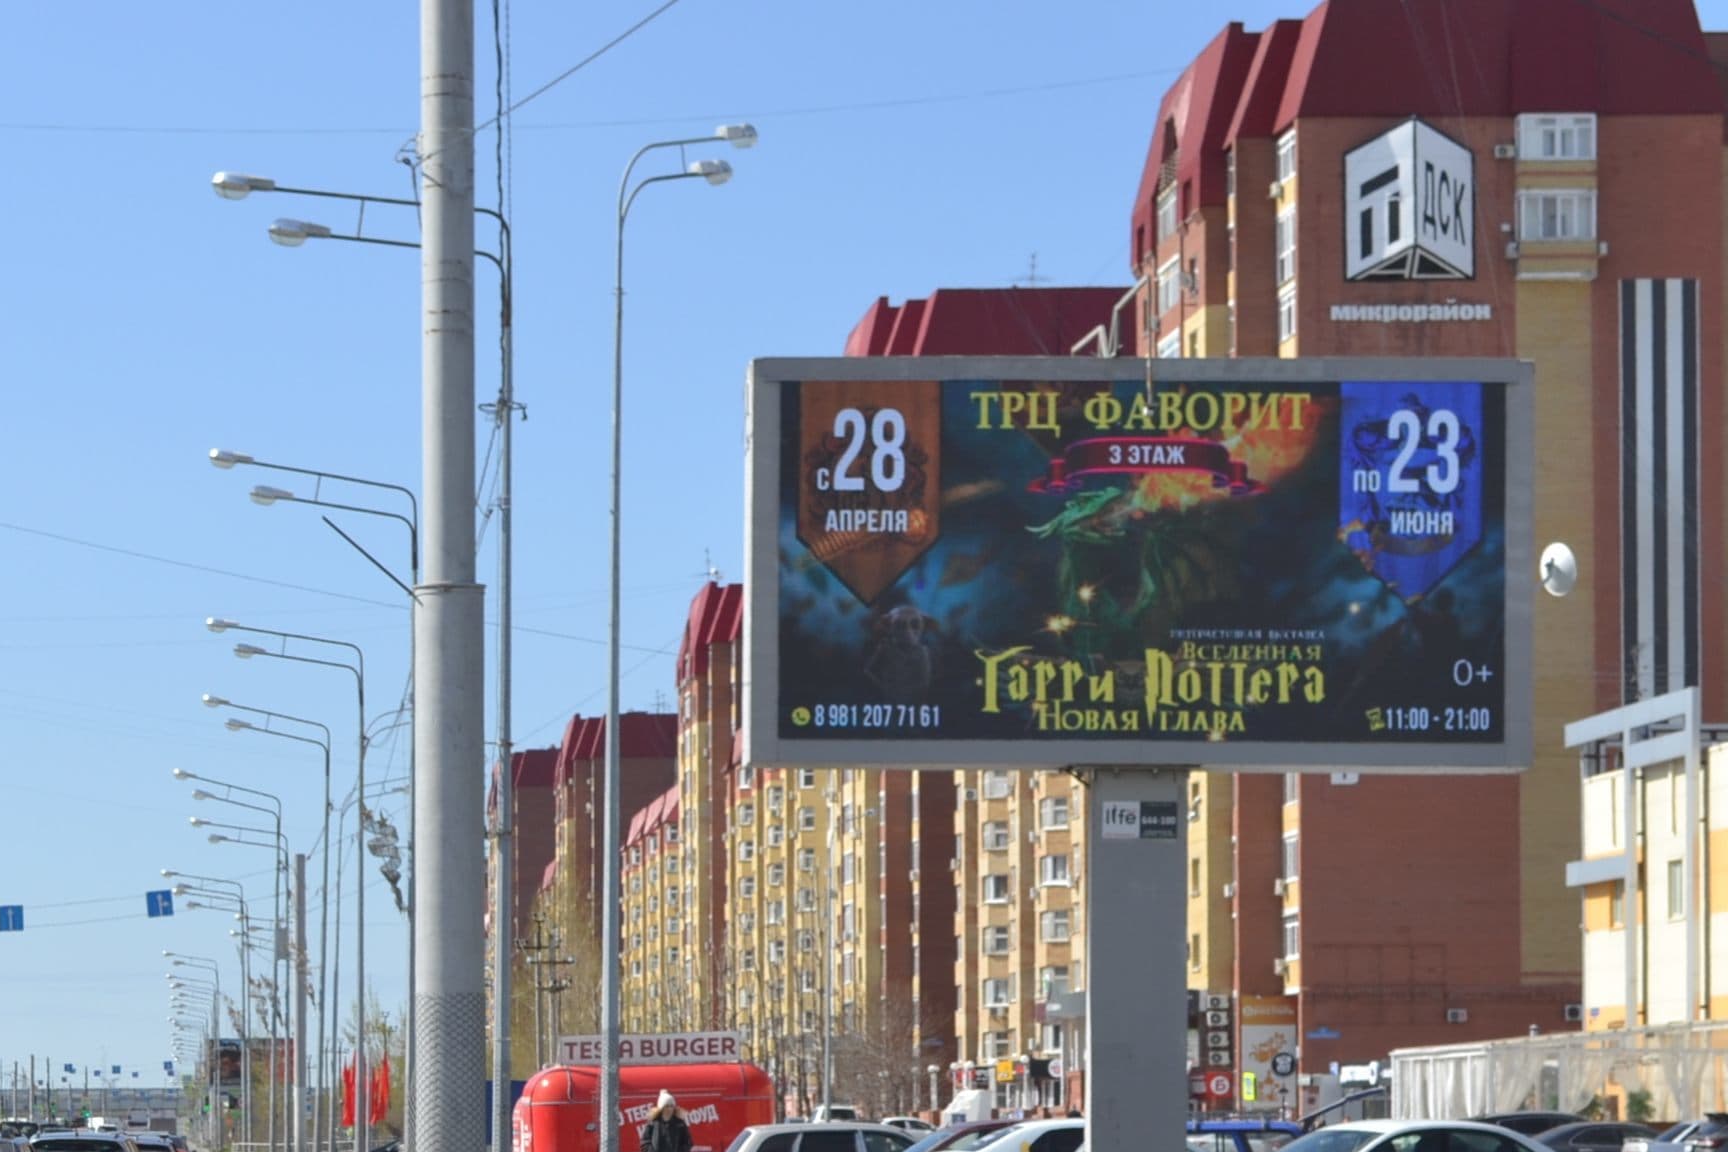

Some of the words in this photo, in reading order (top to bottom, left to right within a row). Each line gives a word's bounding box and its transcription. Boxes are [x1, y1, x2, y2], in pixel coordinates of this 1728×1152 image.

[1422, 160, 1467, 247] ДСК
[1329, 298, 1492, 323] микрорайон
[970, 391, 1061, 438] ТРЦ
[1083, 390, 1312, 431] ФАВОРИТ
[832, 407, 907, 493] 28
[1109, 445, 1122, 465] 3
[1127, 445, 1185, 465] ЭТАЖ
[1387, 408, 1461, 494] 23
[824, 508, 909, 533] АПРЕЛЯ
[1390, 510, 1454, 536] ИЮНЯ
[814, 704, 825, 728] 8
[828, 704, 858, 728] 981
[863, 704, 893, 728] 207
[897, 705, 916, 728] 71
[919, 705, 941, 728] 61
[1385, 707, 1430, 731] 11:00
[1444, 707, 1491, 731] 21:00
[563, 1039, 634, 1061] TESA
[639, 1036, 737, 1059] BURGER
